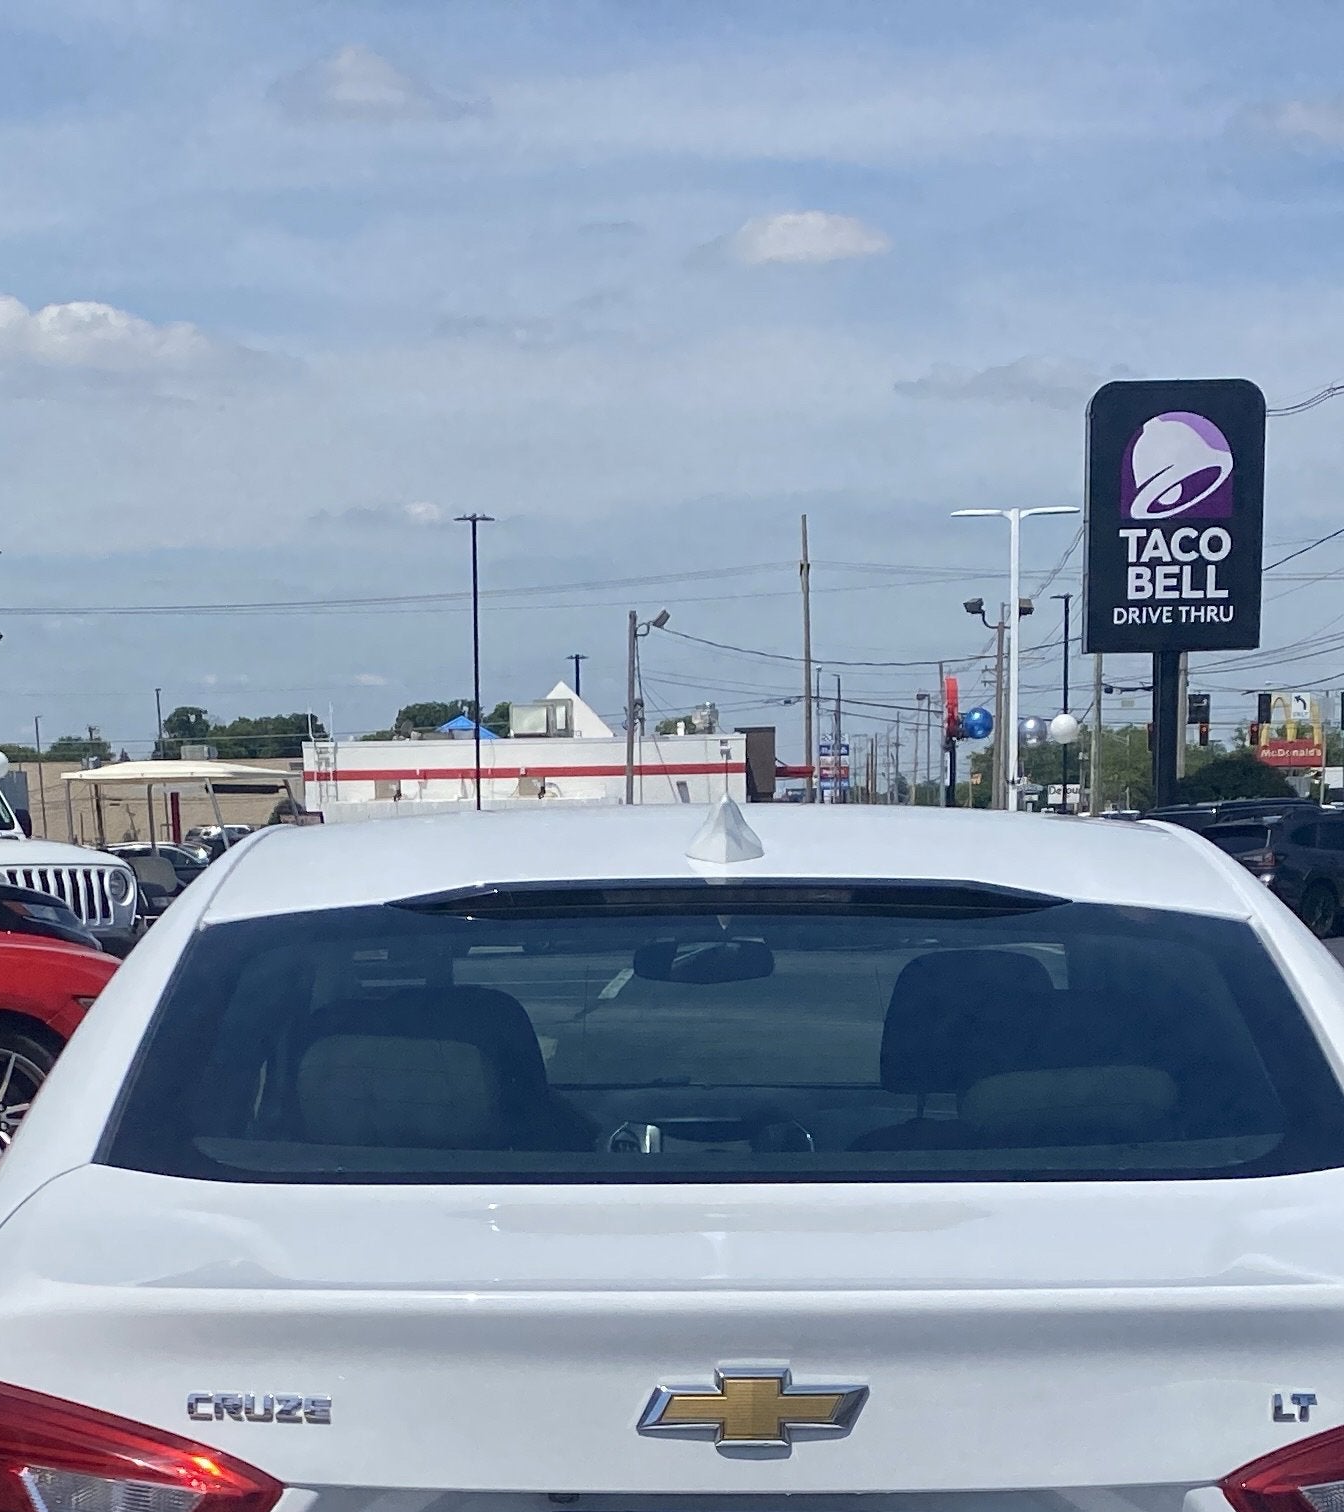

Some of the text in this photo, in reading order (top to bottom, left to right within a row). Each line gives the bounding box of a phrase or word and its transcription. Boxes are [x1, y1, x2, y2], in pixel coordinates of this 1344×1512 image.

[1119, 526, 1232, 562] TACO
[1127, 565, 1229, 600] BELL
[1113, 605, 1234, 625] DRIVE THRU
[187, 1391, 332, 1425] CRUZE
[1273, 1393, 1318, 1423] LT
